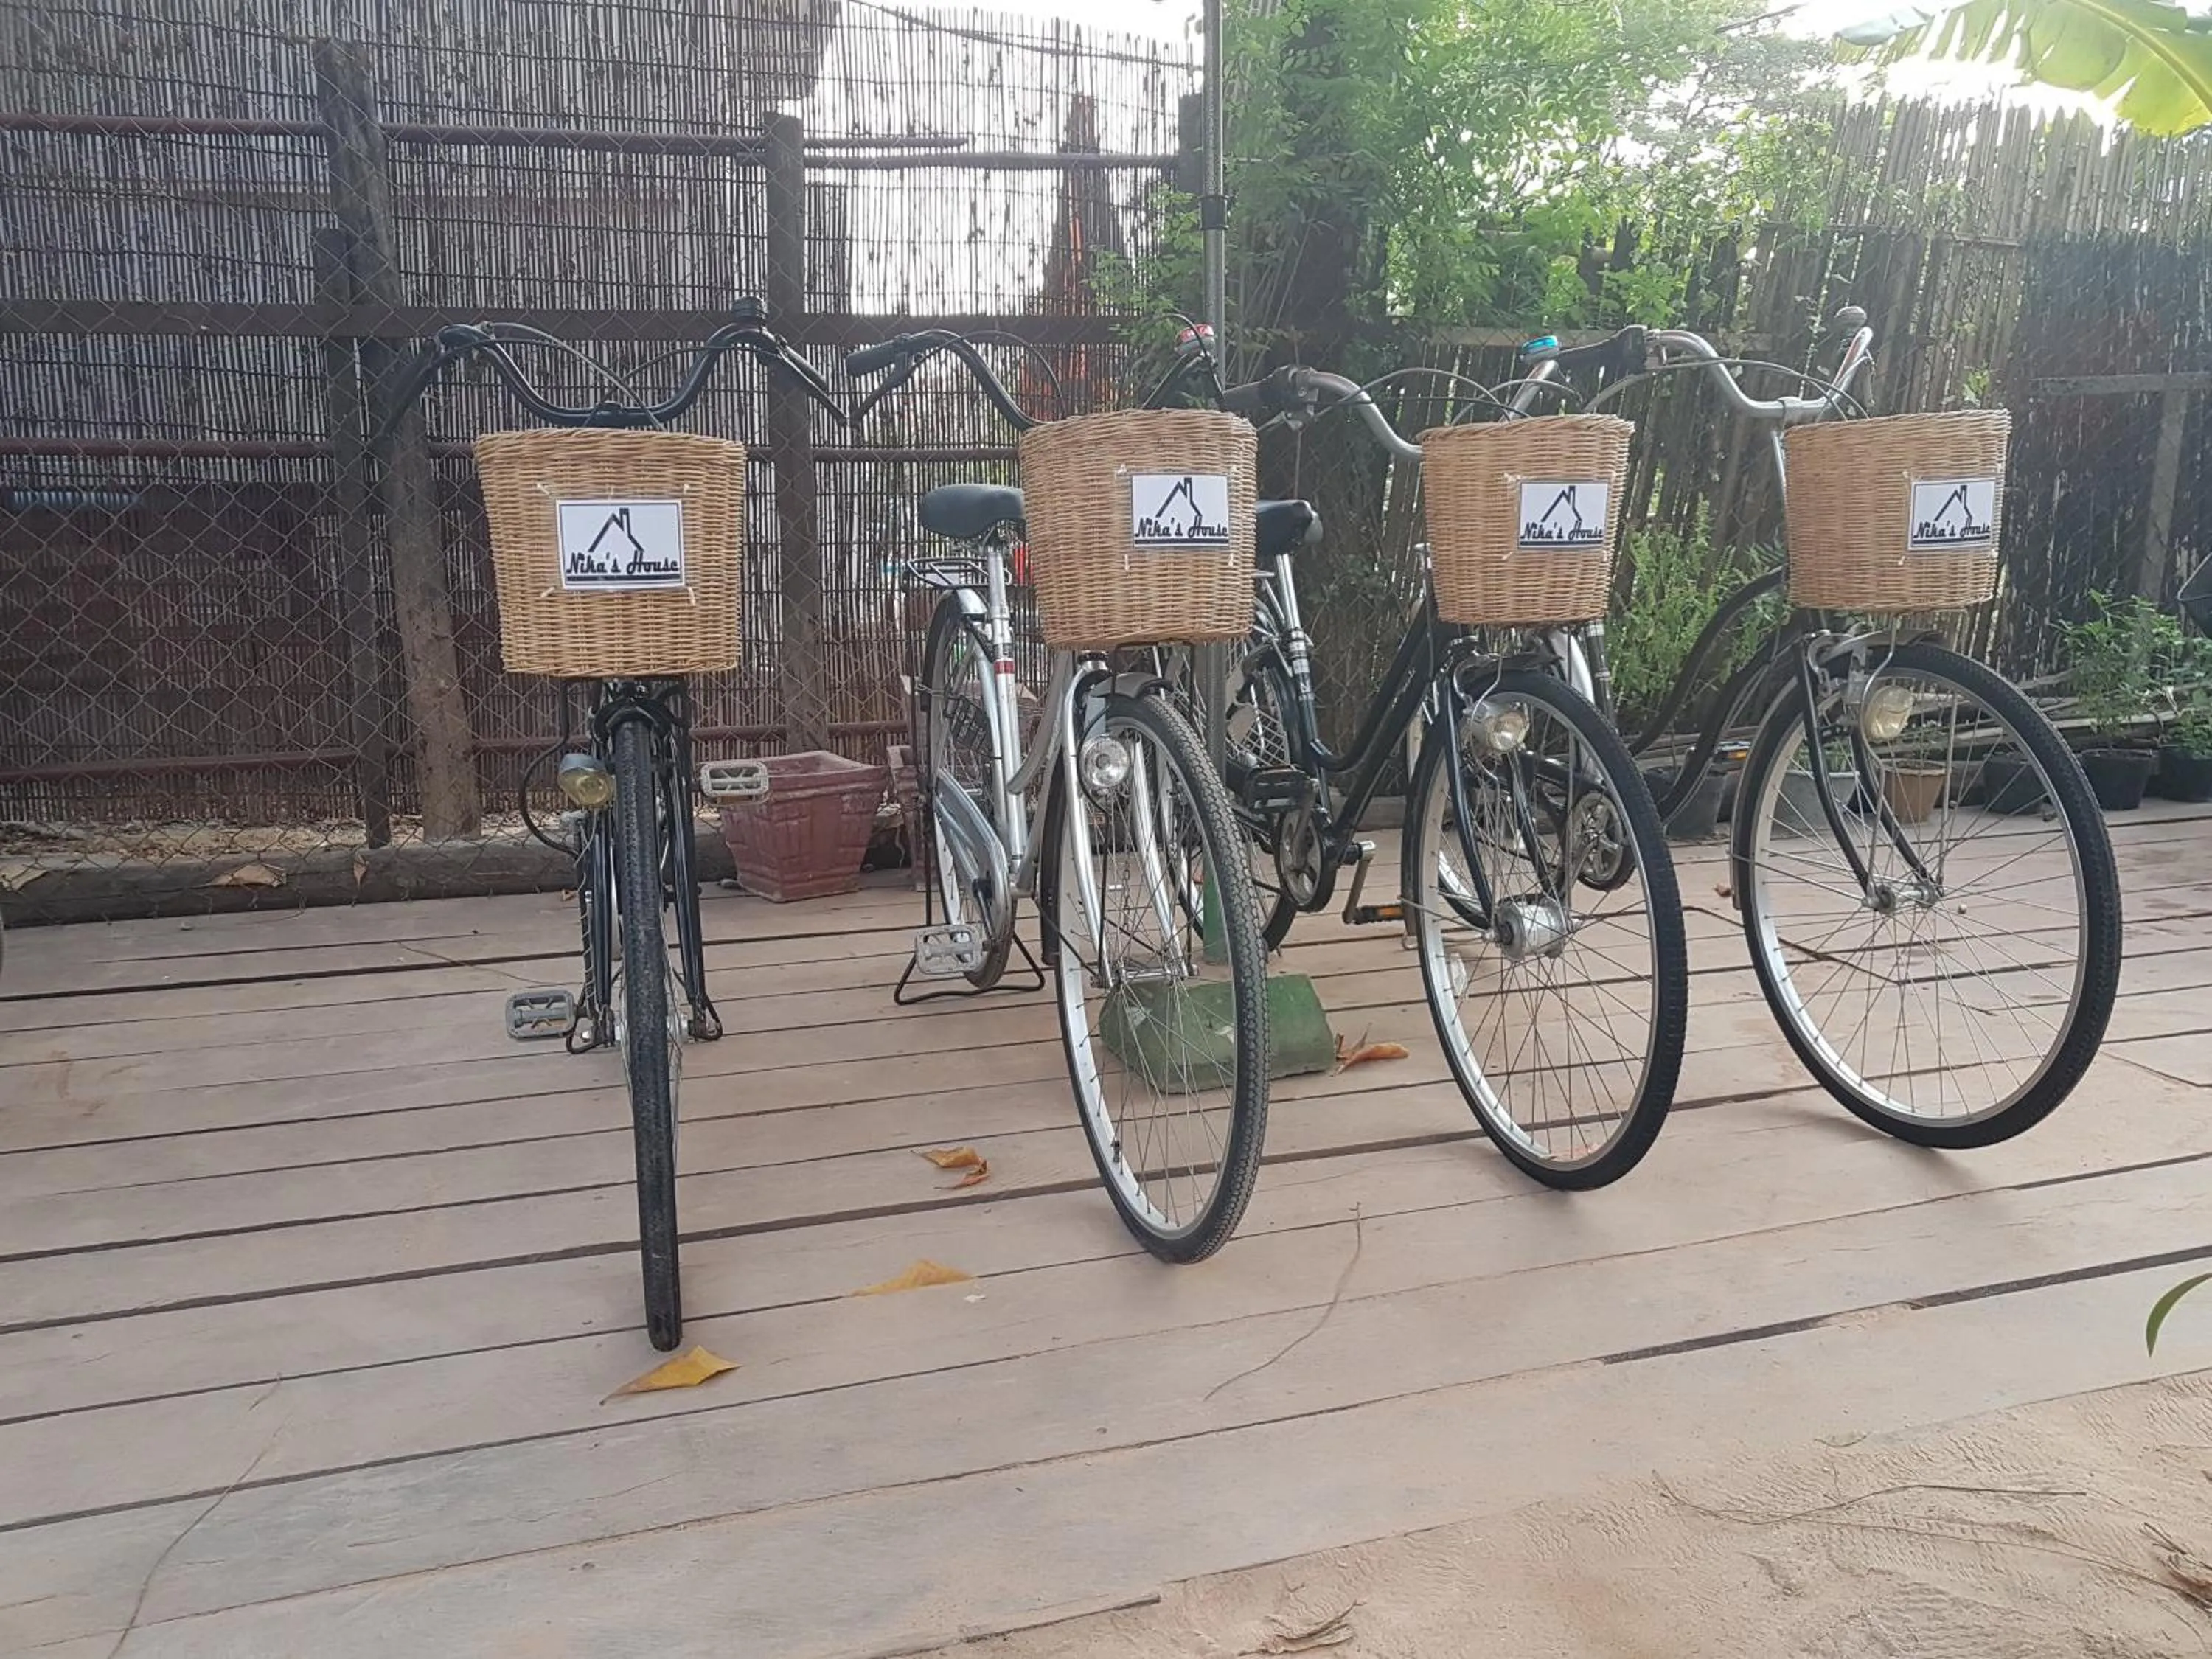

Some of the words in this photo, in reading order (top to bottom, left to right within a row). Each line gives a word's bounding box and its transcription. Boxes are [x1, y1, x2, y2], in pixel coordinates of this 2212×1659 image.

[1135, 518, 1183, 538] Nika's
[1188, 516, 1228, 538] House
[1520, 522, 1563, 540] Nika's
[1568, 520, 1604, 540] House
[566, 552, 621, 574] Nika's
[627, 550, 679, 575] House
